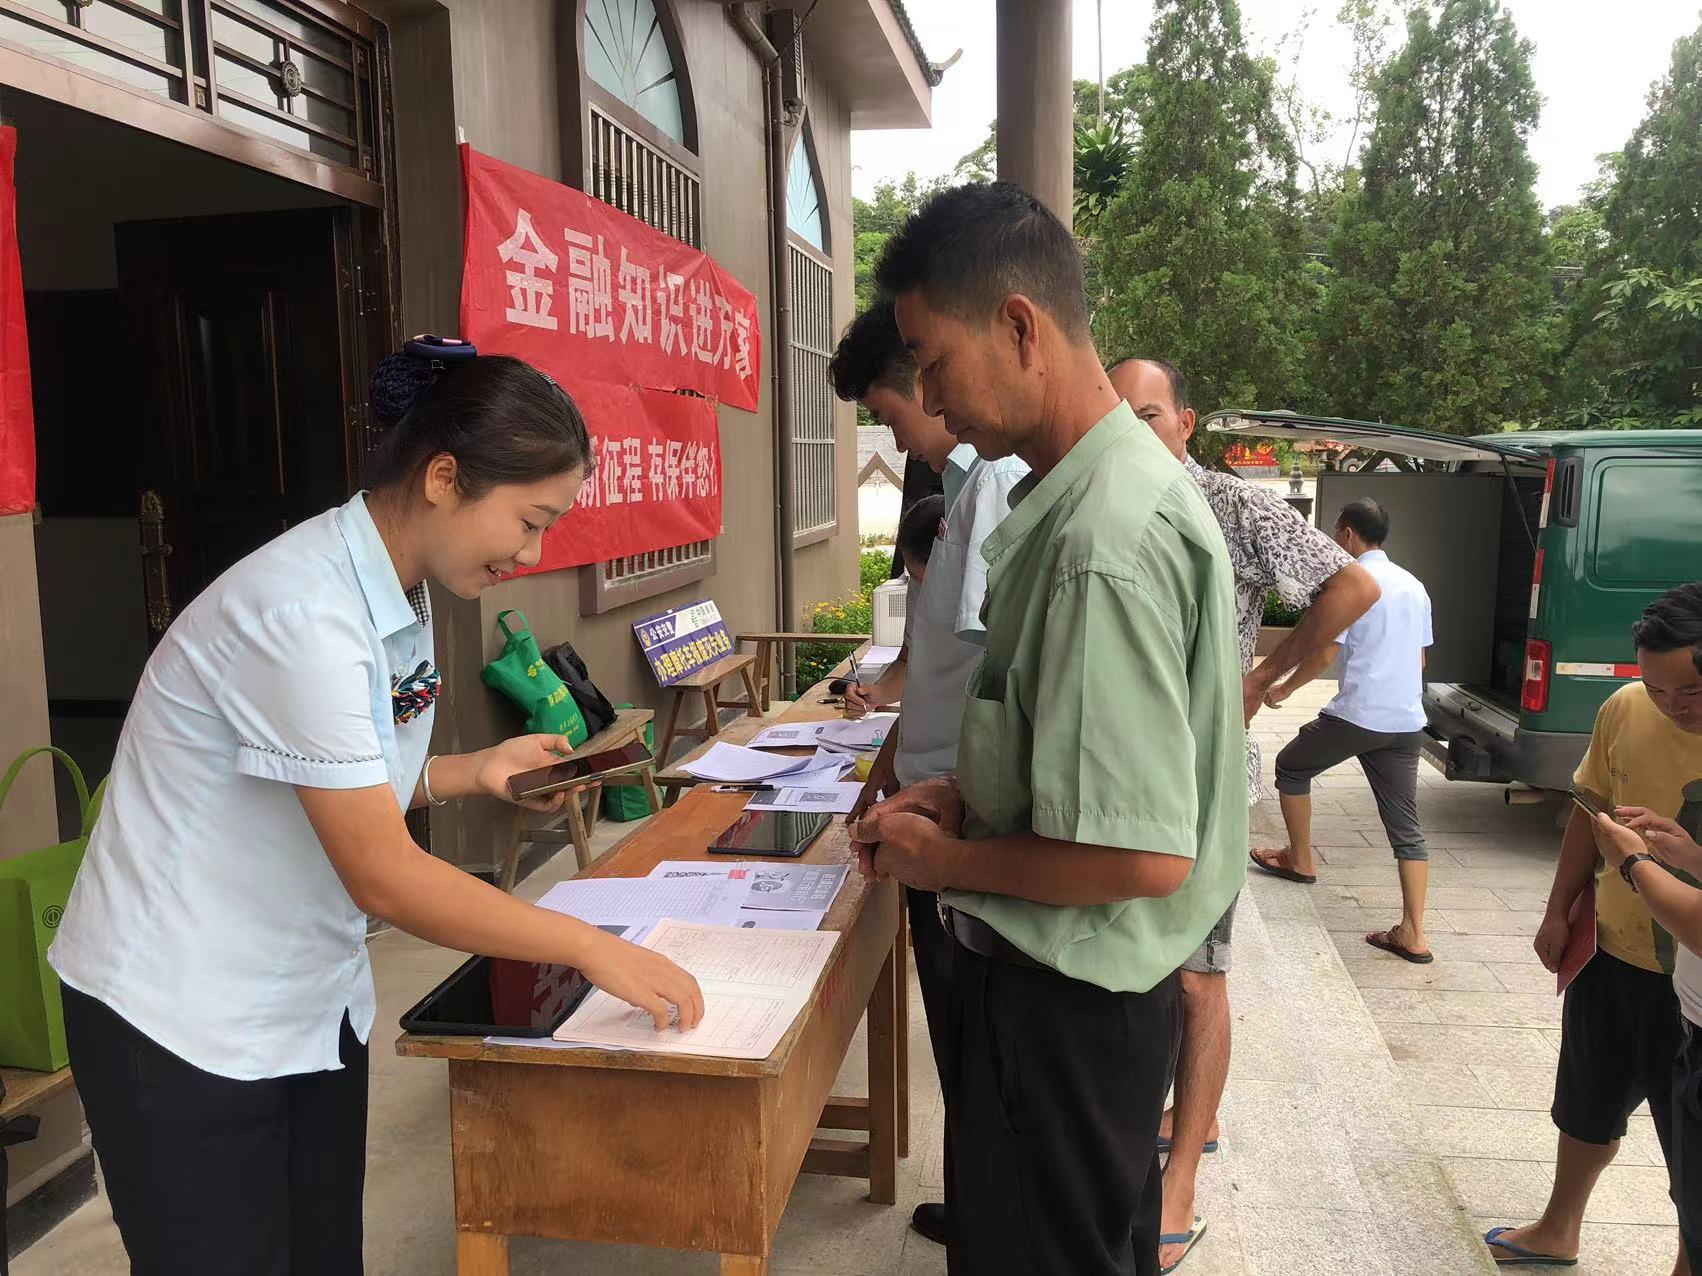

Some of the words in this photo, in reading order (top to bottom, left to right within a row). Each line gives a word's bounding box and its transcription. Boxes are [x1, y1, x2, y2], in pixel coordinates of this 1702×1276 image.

[497, 207, 753, 381] 金融知识进万家
